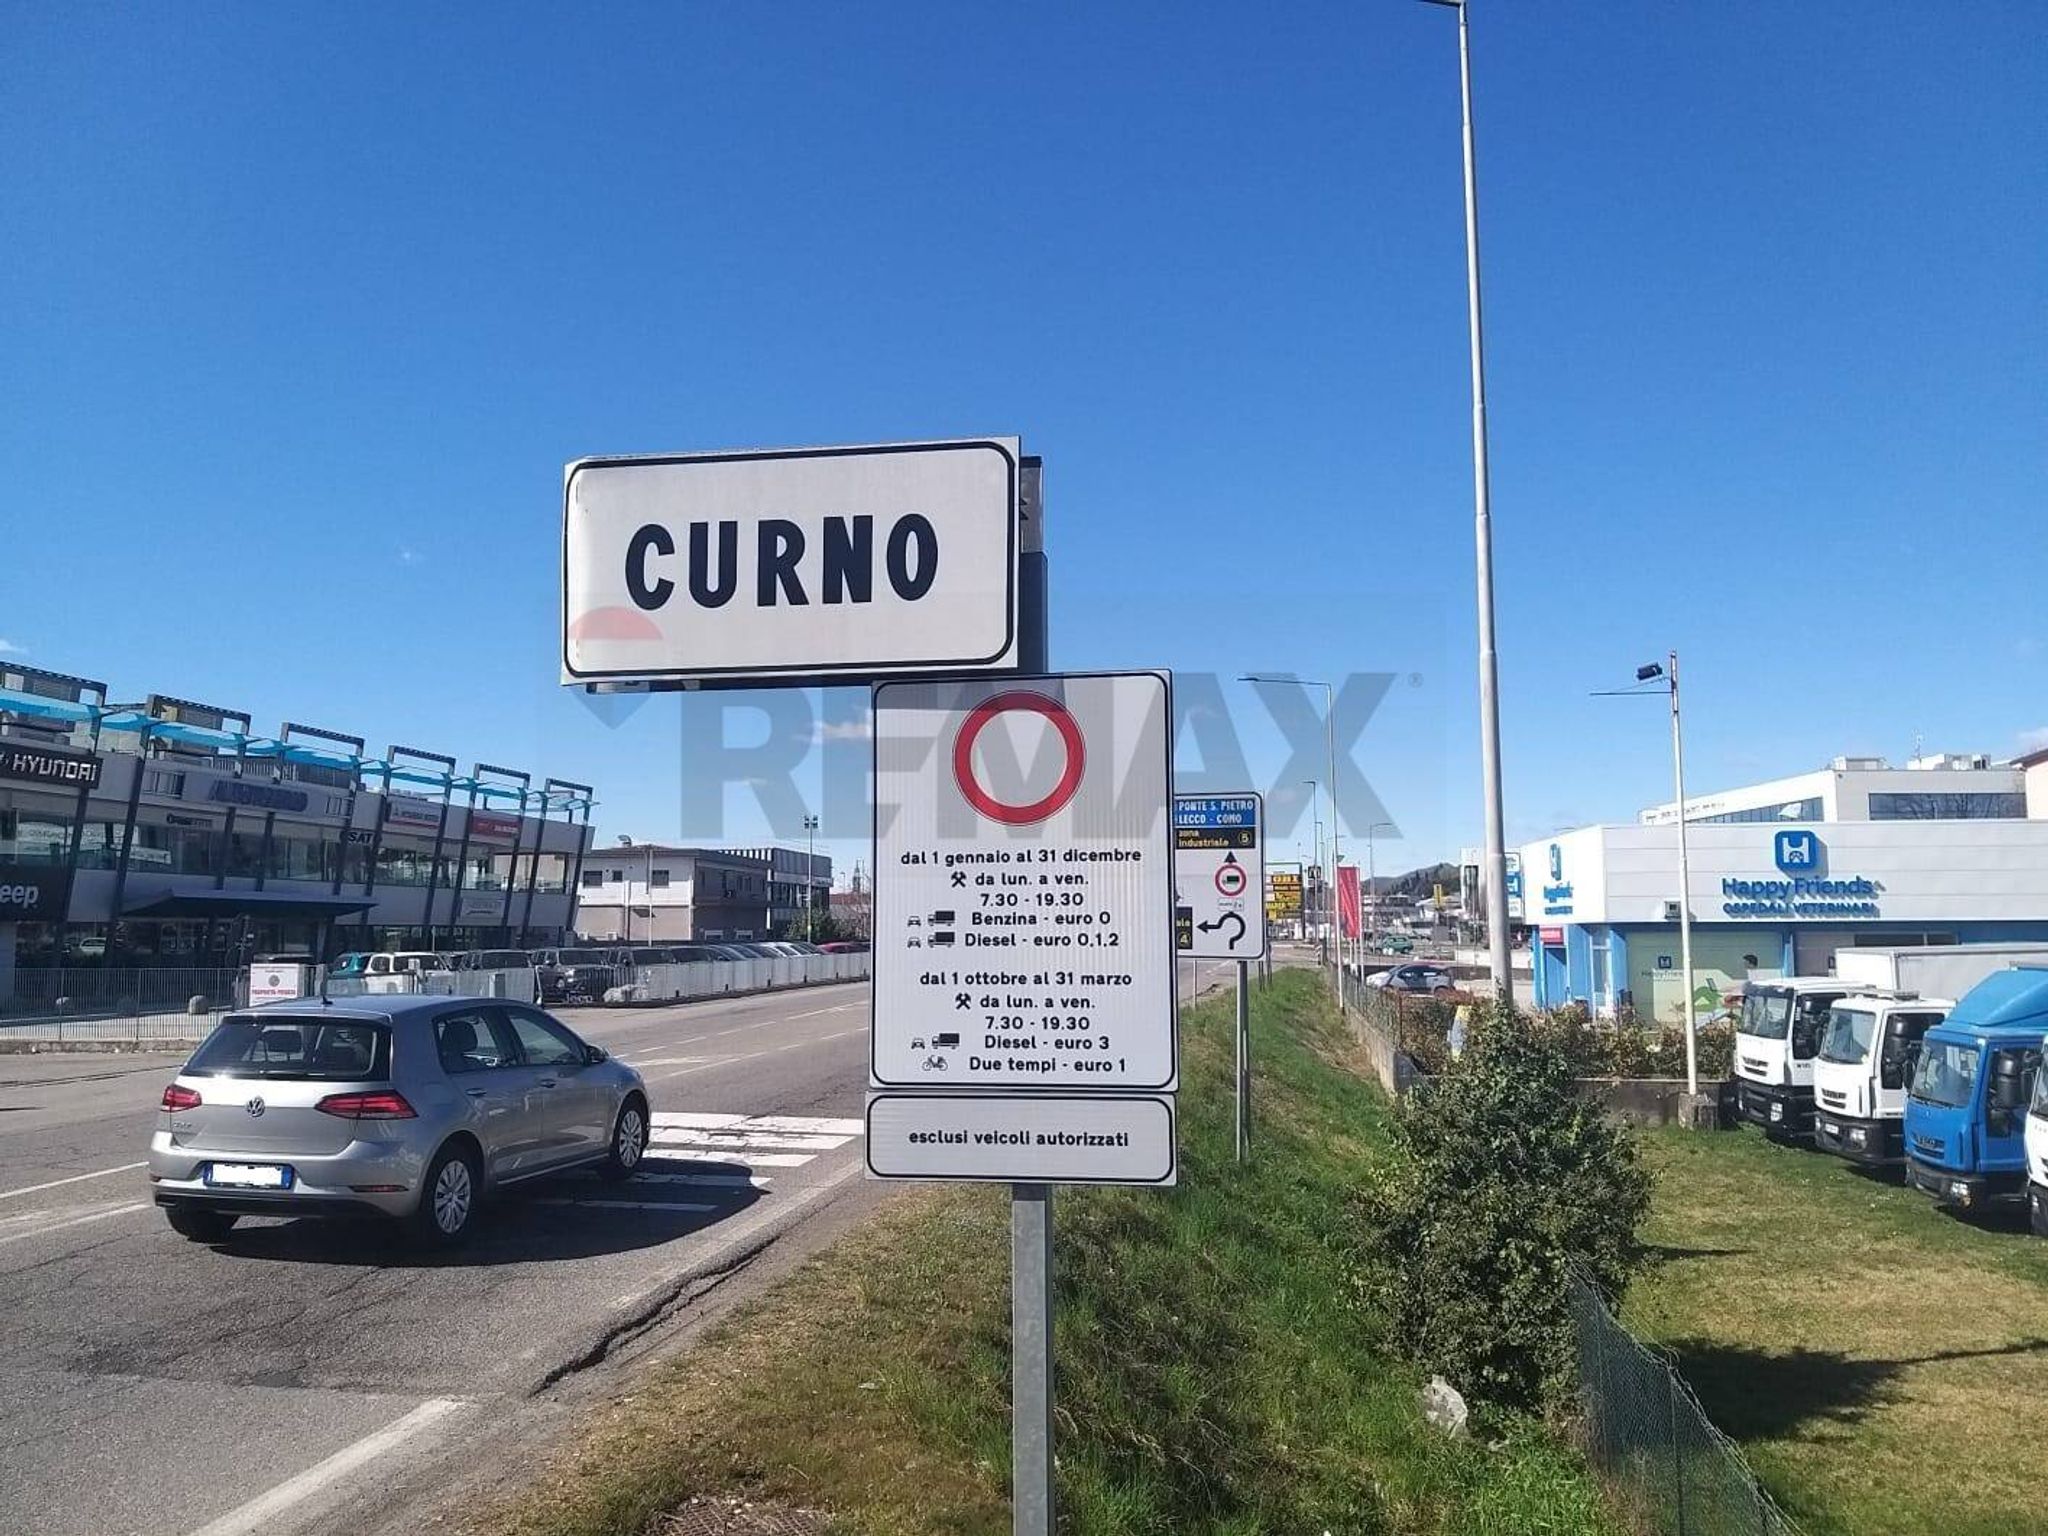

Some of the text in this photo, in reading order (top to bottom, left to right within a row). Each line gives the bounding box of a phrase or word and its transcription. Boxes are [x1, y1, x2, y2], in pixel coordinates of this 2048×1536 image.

[625, 514, 938, 610] CURNO
[12, 753, 98, 781] HYUNDAI
[1179, 801, 1207, 811] PONTE
[1221, 800, 1253, 811] PIETRO
[1179, 814, 1206, 824] LECCO
[1217, 813, 1242, 824] COMO
[1178, 839, 1229, 847] industriale
[901, 849, 1141, 867] dal 1 gennaio al 31 dicembre
[976, 873, 1088, 885] da lun. a ven.
[0, 884, 39, 908] eep
[981, 894, 1017, 906] 7.30
[1037, 893, 1083, 906] 19.30
[1723, 902, 1875, 914] OSPEDALI VETERINARI
[972, 912, 1036, 925] Benzina
[1055, 915, 1093, 924] euro
[1100, 912, 1110, 924] 0
[965, 933, 1016, 946] Diesel
[1034, 936, 1071, 946] euro
[1078, 933, 1118, 947] 0.1.2
[920, 972, 1131, 985] dal 1 ottobre al 31 marzo
[980, 995, 1094, 1008] da lun. a ven.
[986, 1016, 1023, 1029] 7.30
[1042, 1017, 1089, 1030] 19.30
[985, 1035, 1036, 1048] Diesel
[1055, 1039, 1092, 1049] euro
[1100, 1036, 1109, 1049] 3
[970, 1057, 1001, 1070] Due
[1008, 1058, 1055, 1073] tempi
[1075, 1061, 1112, 1071] euro
[1120, 1059, 1124, 1072] 1
[909, 1130, 1128, 1146] esclusi veicoli autorizzati
